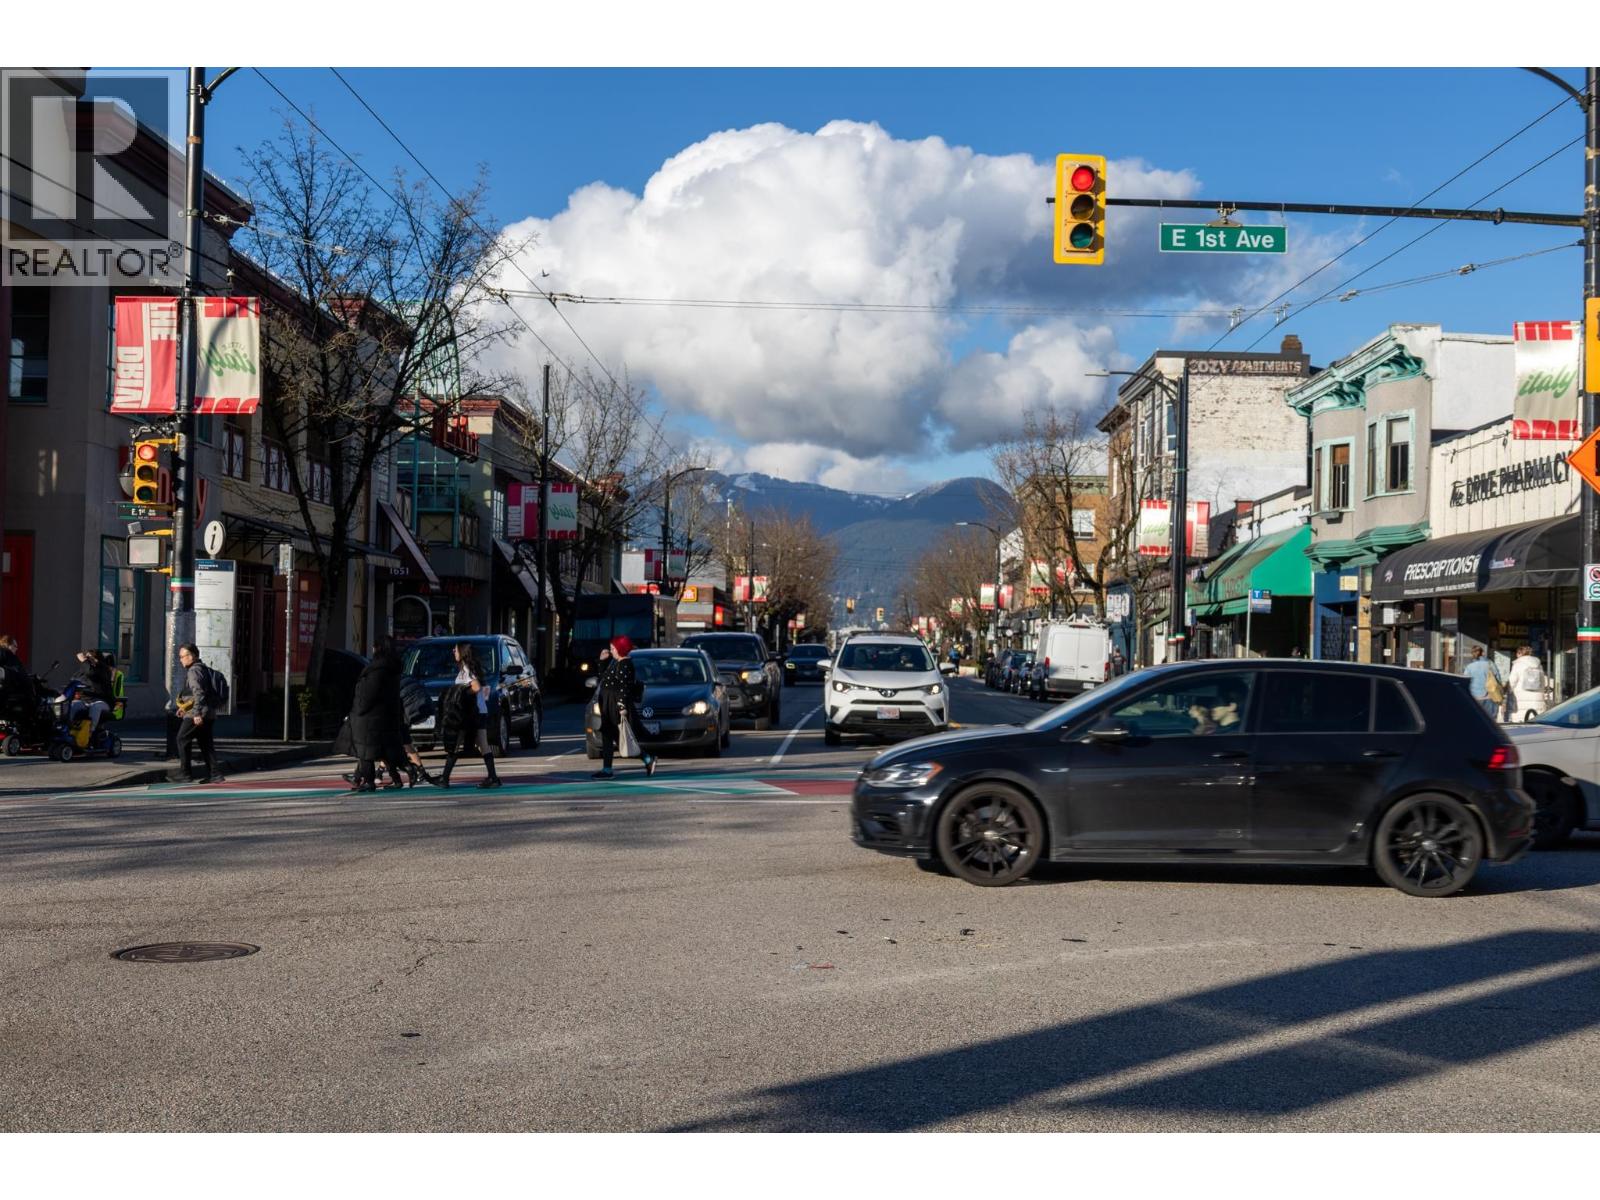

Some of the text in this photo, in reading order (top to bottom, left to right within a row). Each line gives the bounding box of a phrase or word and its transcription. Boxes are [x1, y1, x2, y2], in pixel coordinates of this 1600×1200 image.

[1172, 229, 1275, 249] E 1st Ave
[1189, 359, 1302, 375] COZY APARTMENTS
[1519, 364, 1577, 399] italy
[1466, 469, 1498, 505] DRIVE
[1499, 450, 1574, 494] PHARMACY
[389, 567, 409, 575] 1651
[1403, 555, 1475, 582] PRESCRIPTIONS
